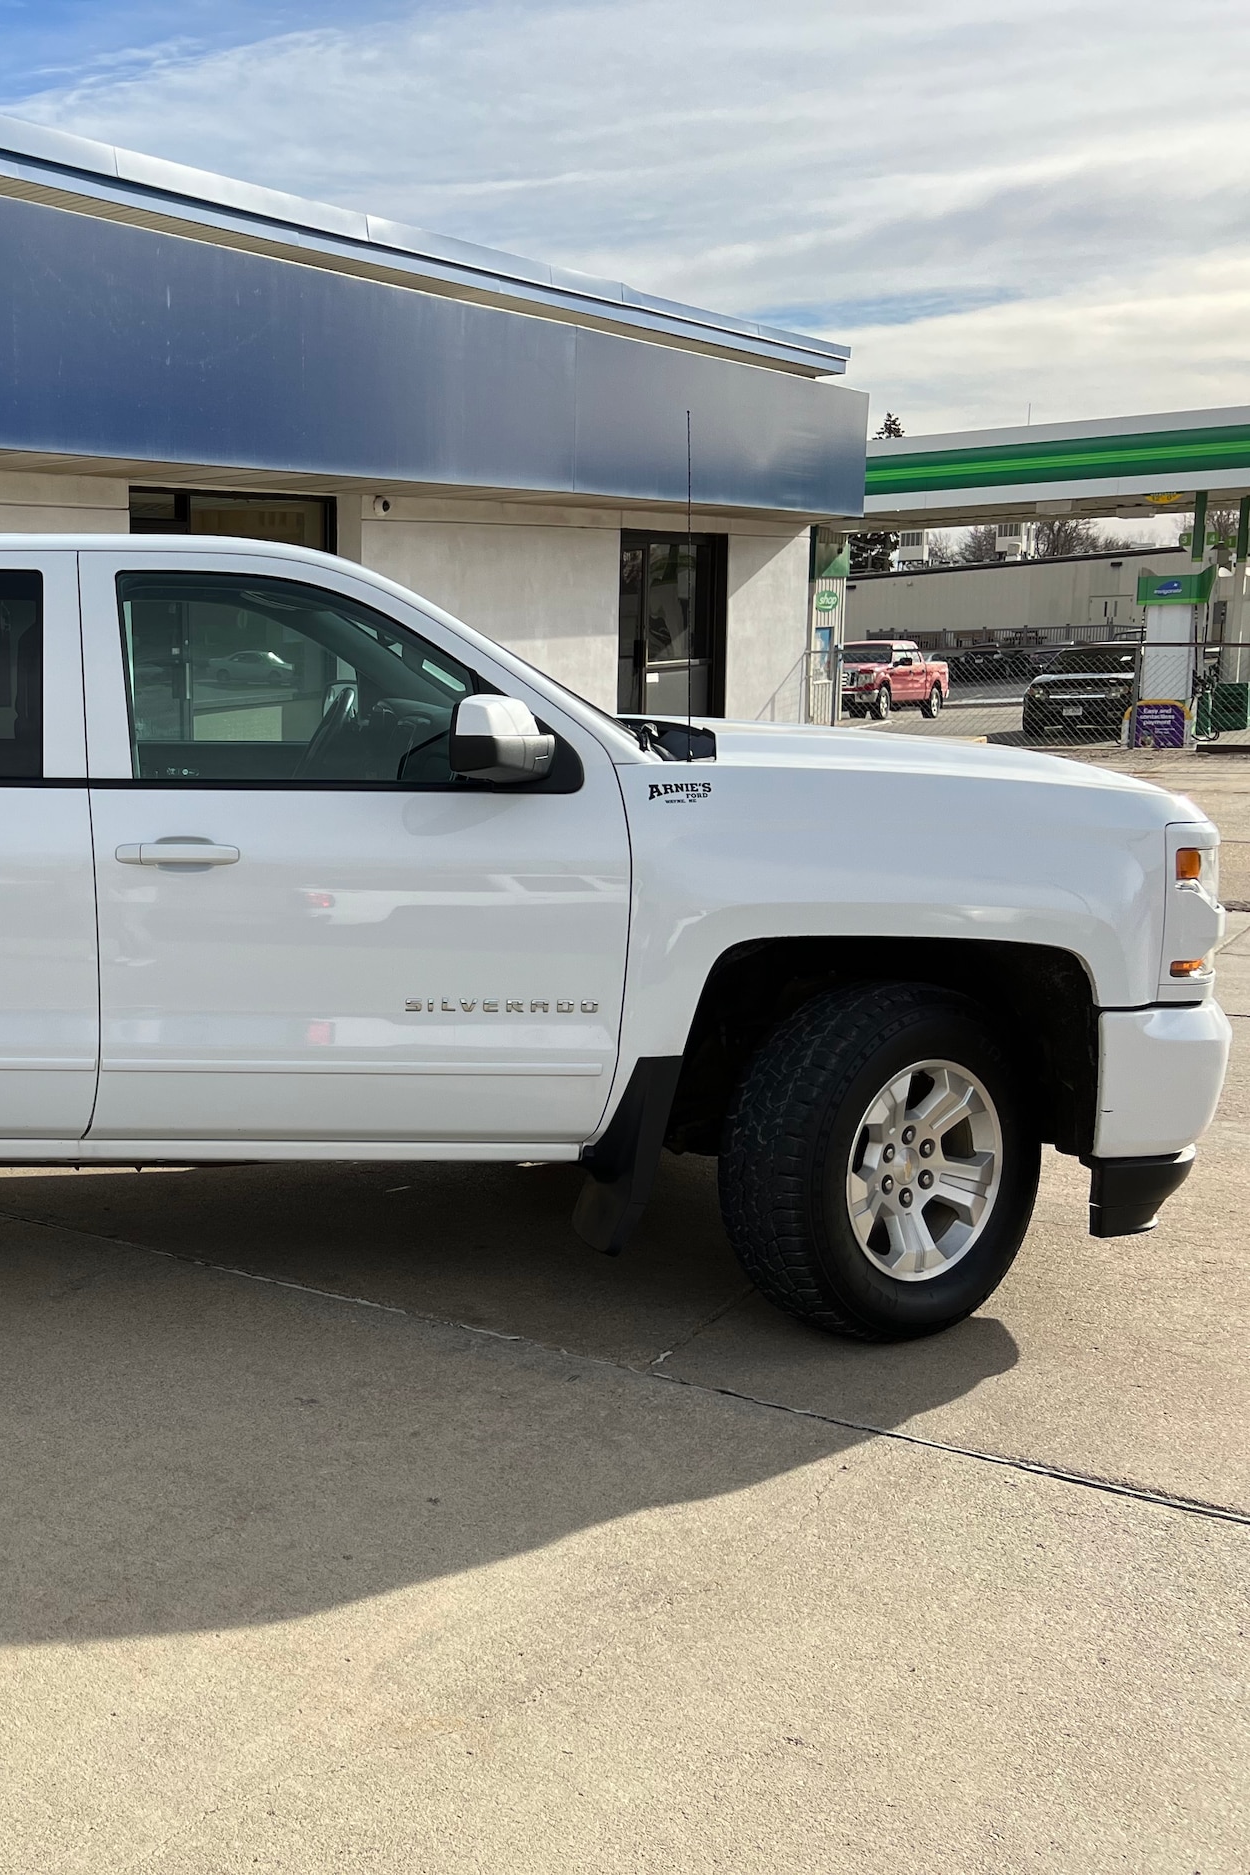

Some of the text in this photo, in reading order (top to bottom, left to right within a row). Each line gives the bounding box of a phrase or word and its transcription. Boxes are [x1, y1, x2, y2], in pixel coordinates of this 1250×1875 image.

[819, 592, 837, 608] shop
[1143, 707, 1159, 715] Easy
[648, 782, 712, 800] ARNIE'S
[405, 997, 599, 1013] SILVERADO
